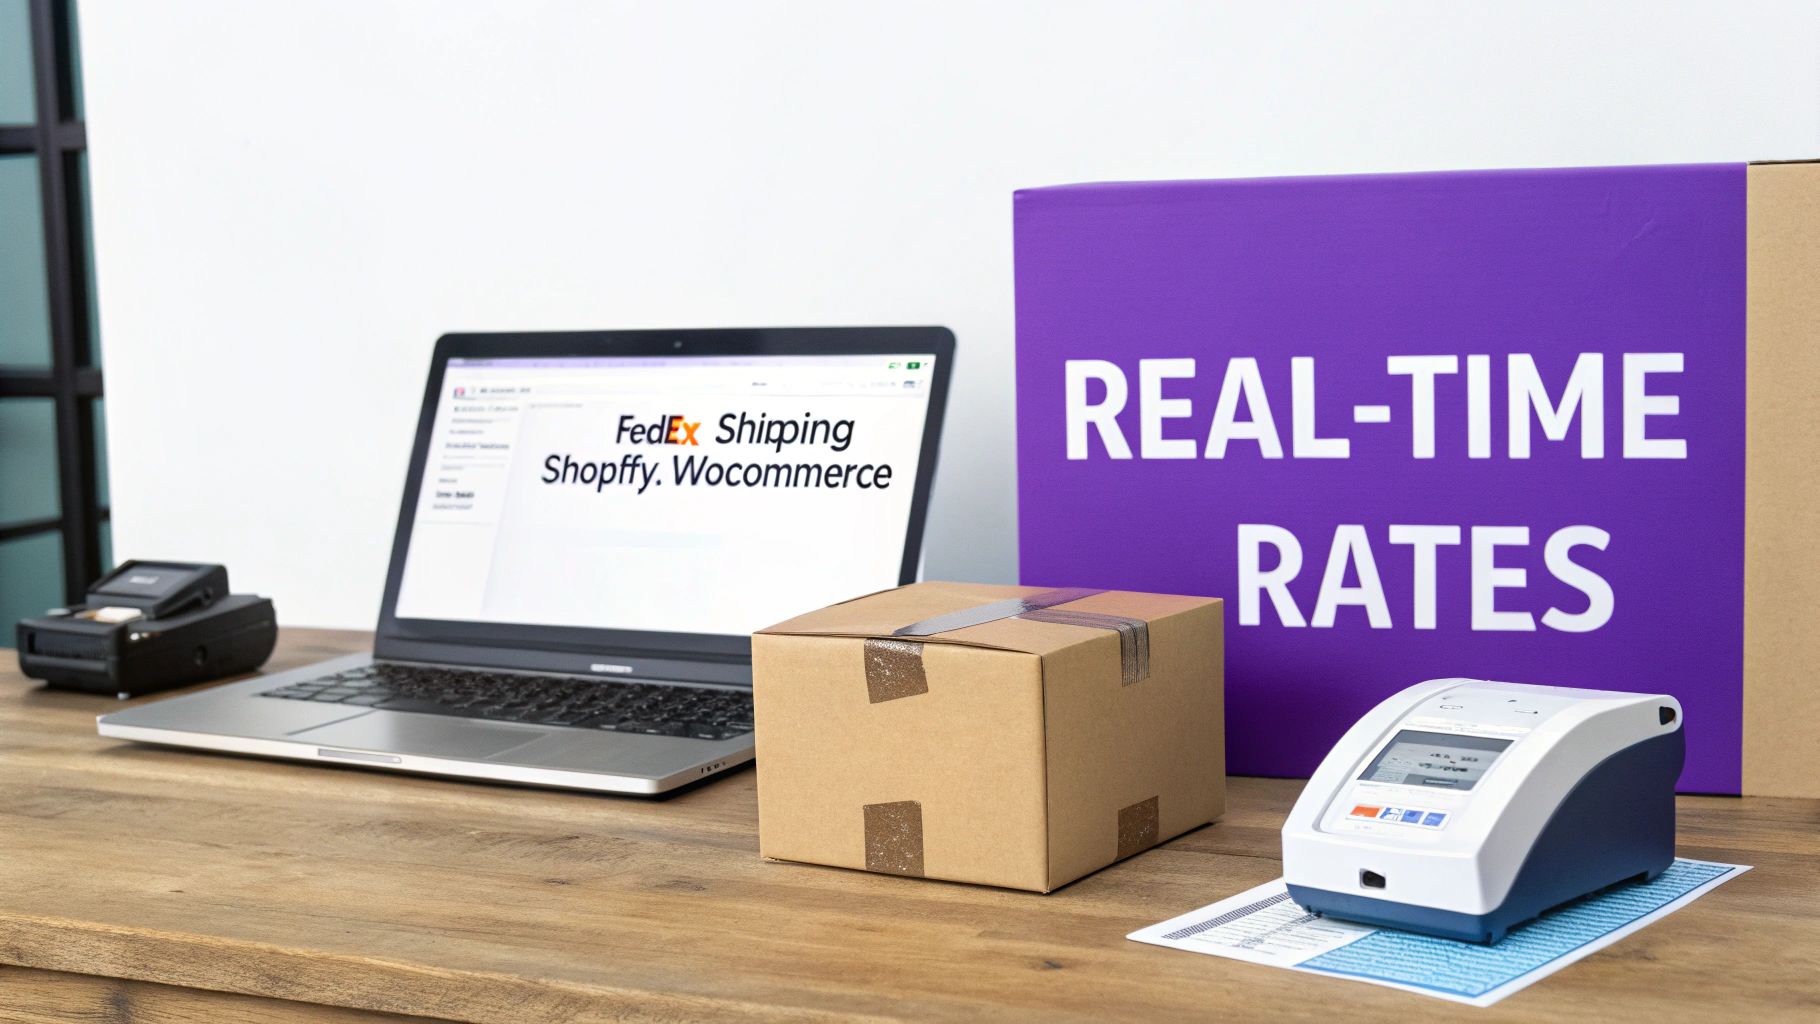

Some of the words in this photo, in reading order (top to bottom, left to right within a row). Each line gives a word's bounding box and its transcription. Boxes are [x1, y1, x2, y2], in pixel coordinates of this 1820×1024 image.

[616, 414, 701, 446] FedEx
[1064, 352, 1688, 460] REAL-TIME
[673, 454, 893, 490] Wocommerce
[1237, 523, 1615, 633] RATES
